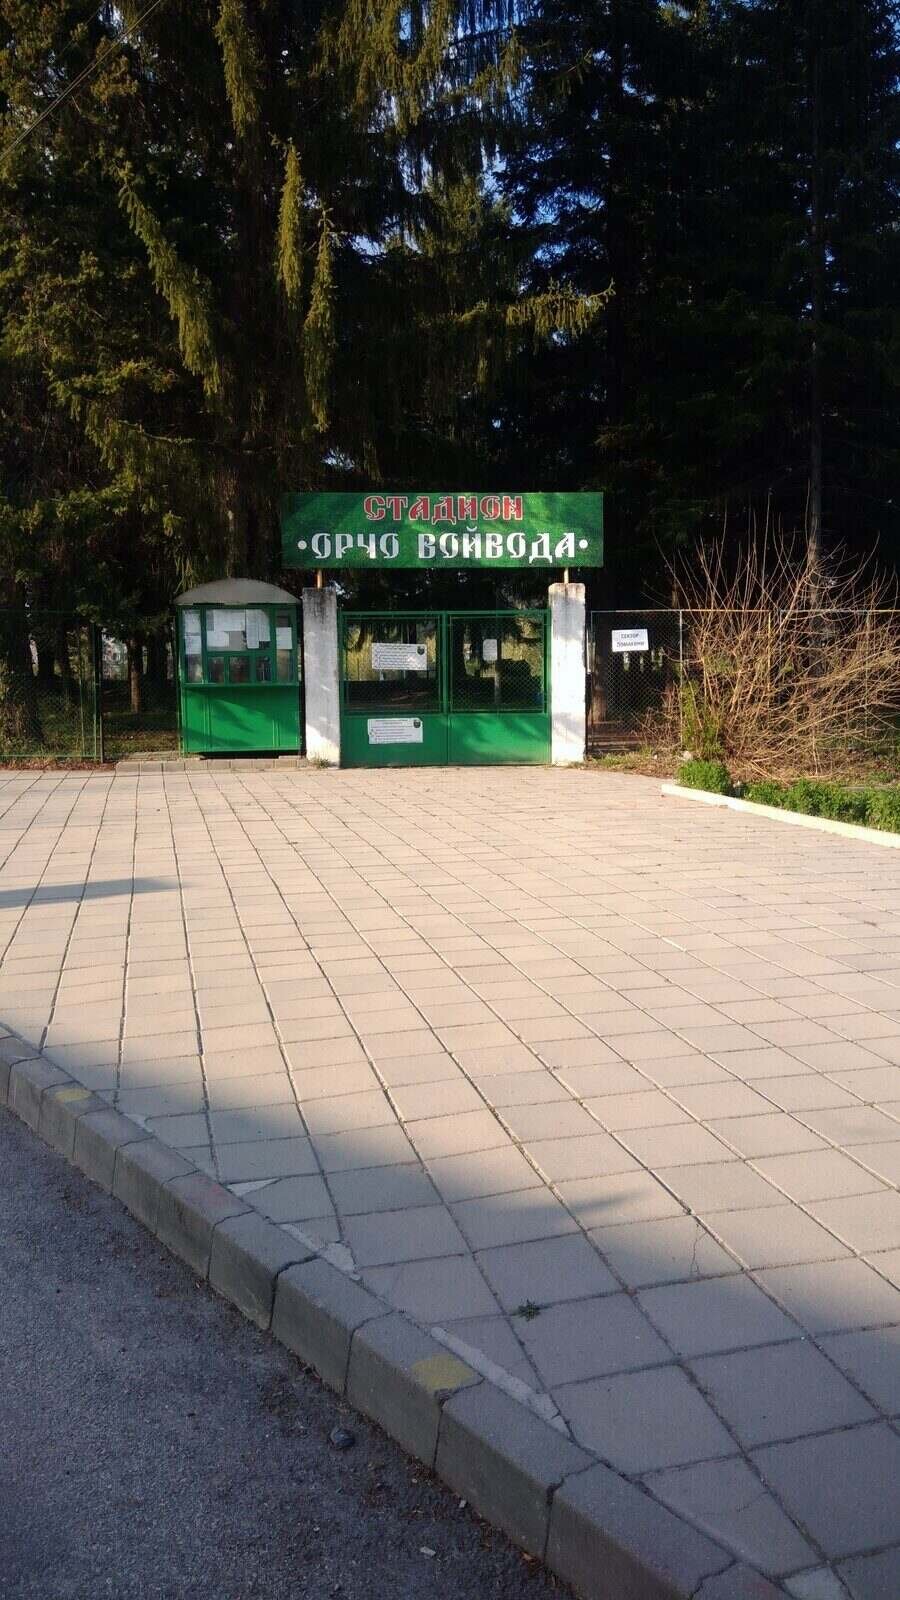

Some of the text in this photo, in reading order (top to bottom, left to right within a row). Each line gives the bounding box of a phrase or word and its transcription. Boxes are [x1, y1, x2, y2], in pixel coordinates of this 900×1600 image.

[363, 495, 524, 525] СТАДИОН
[311, 527, 576, 564] ОРЧО ВОЙВОДА
